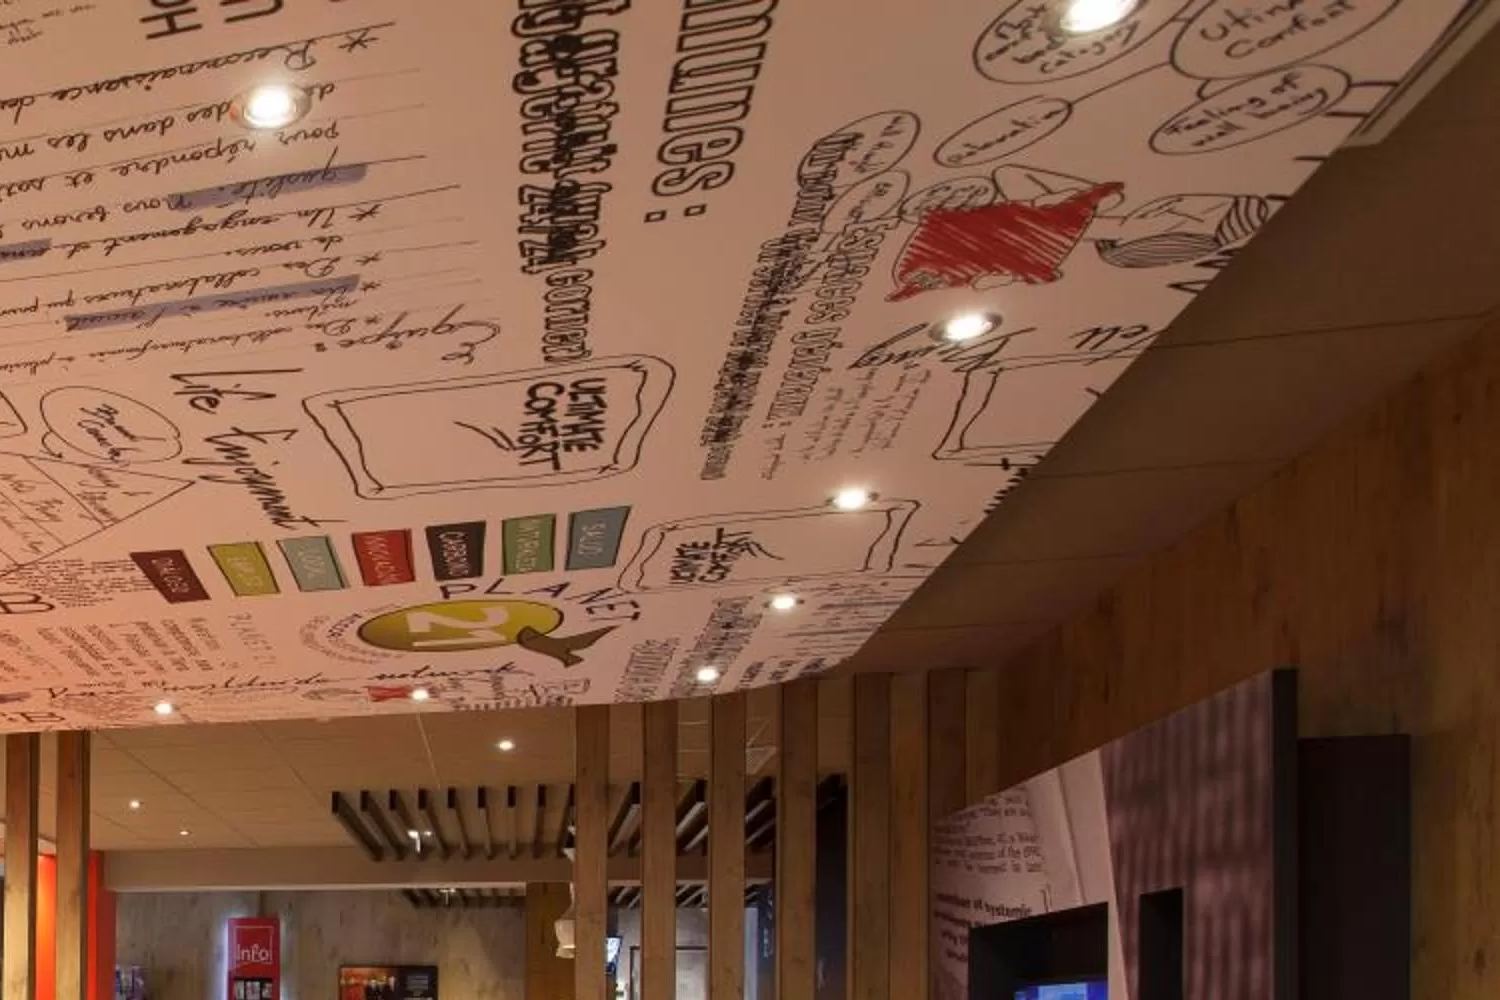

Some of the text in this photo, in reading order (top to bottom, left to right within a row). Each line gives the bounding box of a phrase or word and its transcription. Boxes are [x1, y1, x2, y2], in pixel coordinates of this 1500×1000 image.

[47, 132, 90, 153] les
[102, 117, 175, 142] dans
[109, 138, 255, 177] répondre
[170, 367, 304, 415] Life
[517, 381, 565, 471] COMFORT
[562, 377, 607, 452] ULTIMATE
